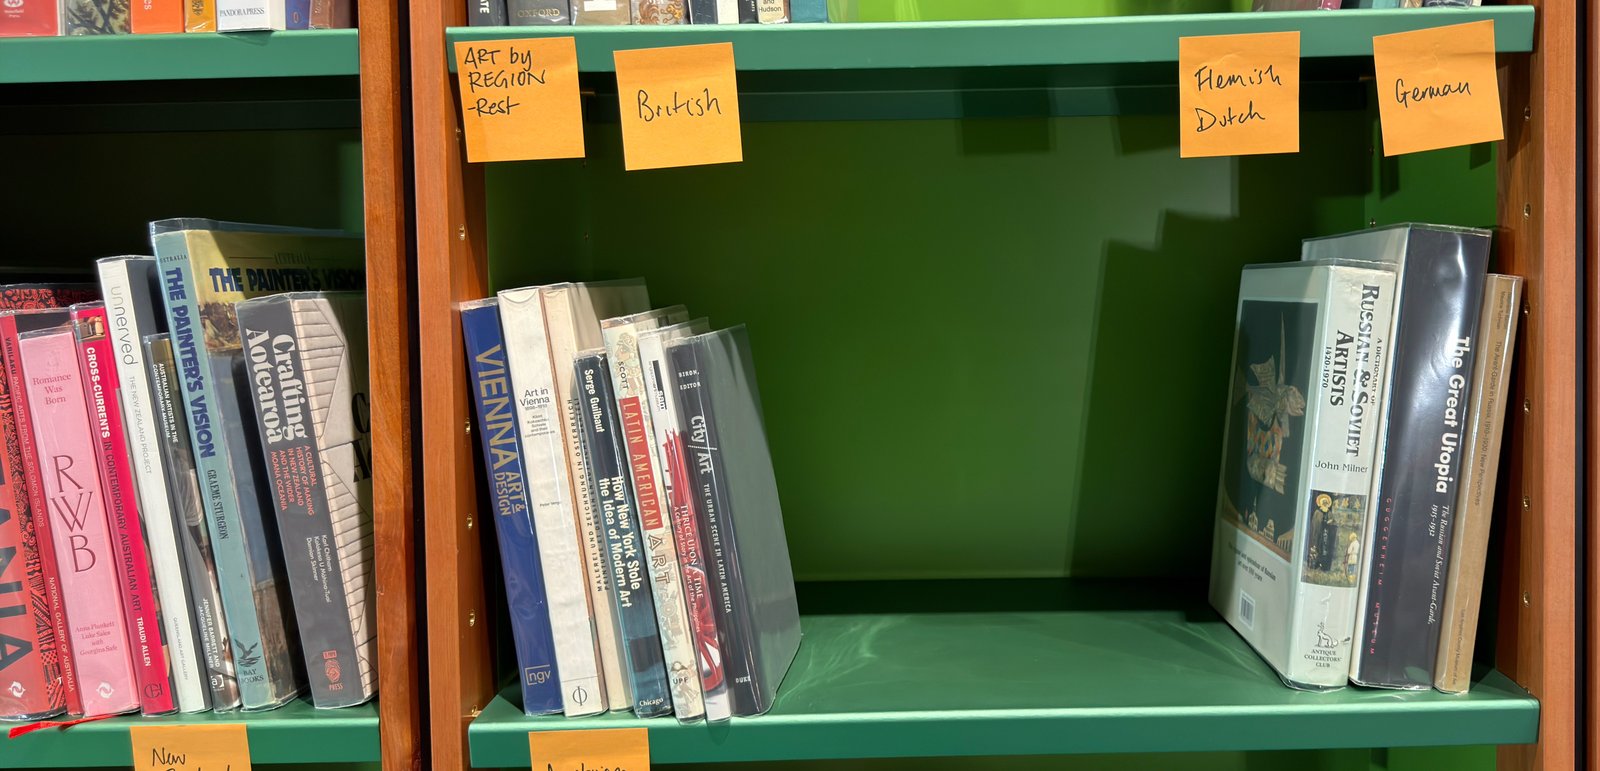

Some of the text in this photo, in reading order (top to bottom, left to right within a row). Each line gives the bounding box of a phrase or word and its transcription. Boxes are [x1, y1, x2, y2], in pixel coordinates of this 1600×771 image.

[220, 7, 265, 17] PANDORA PRESS
[517, 9, 560, 17] OXFORD
[464, 47, 533, 71] ART by
[469, 69, 546, 93] REGION
[1194, 65, 1282, 91] Flemish
[1395, 78, 1471, 108] German
[637, 88, 721, 121] British
[1195, 101, 1265, 132] Dutch
[209, 267, 243, 292] THE
[107, 284, 138, 366] unnerved
[33, 374, 71, 385] Romance
[164, 266, 215, 458] THE PAINTER'S VISION
[617, 360, 628, 390] SCOTT
[1321, 345, 1332, 388] 1420-1970
[1328, 329, 1354, 407] ARTISTS
[1343, 283, 1380, 457] RUSSIAN & SOVIET
[1371, 345, 1382, 392] DICTIONARY
[45, 386, 63, 394] Was
[246, 328, 283, 444] Aotearoa
[273, 334, 308, 440] Crafting
[525, 387, 549, 398] Art in
[582, 368, 597, 395] Serge
[680, 382, 701, 390] EDITOR
[45, 396, 66, 405] Born
[158, 362, 169, 398] AUSTRALIAN
[165, 399, 174, 423] ARTISTS
[170, 431, 178, 443] THE
[474, 343, 520, 470] VIENNA
[520, 396, 550, 407] Vienna
[589, 396, 605, 433] Guilbaut
[1430, 334, 1471, 494] The Great Utopia
[4, 336, 44, 527] VARILAKU PACIFIC ARTS FROM THE SOLOMON ISLANDS
[128, 376, 151, 474] THE NEW ZEALAND PROJECT
[687, 414, 712, 474] City Art
[85, 346, 142, 612] CROSS-CURRENTS IN CONTEMPORARY AUSTRALIAN ART
[270, 451, 287, 510] MOANA OCEANIA
[279, 449, 294, 503] AND THE WIDER
[289, 456, 297, 473] NEW
[295, 446, 314, 515] HISTORY OF MAKING
[305, 451, 317, 486] CULTURAL
[576, 460, 583, 471] IN
[622, 401, 660, 526] LATIN AMERICAN
[1315, 460, 1368, 473] John Milner
[206, 468, 229, 539] GRAEME STURGEON
[292, 474, 303, 506] ZEALAND
[493, 471, 512, 516] DESIGN
[506, 469, 525, 512] ART &
[578, 474, 592, 526] ZEICHNUNG
[680, 503, 693, 536] THRICE
[1440, 504, 1450, 519] The
[587, 530, 596, 548] UND
[597, 477, 632, 608] the Idea of Modern Art
[610, 475, 643, 589] How New York Stole
[703, 483, 731, 613] THE URBAN SCENE IN LATIN AMERICA
[1437, 518, 1448, 544] Russian
[645, 532, 672, 585] ART
[686, 538, 698, 565] UPON
[1433, 559, 1443, 579] Soviet
[1435, 545, 1445, 559] and
[310, 560, 319, 581] Skinner
[590, 551, 603, 592] MALEREI
[693, 576, 704, 598] TIME
[1368, 497, 1392, 654] GUGGENHEIM MUSEUM
[49, 576, 74, 692] NATIONAL GALLERY OF AUSTRALIA
[135, 616, 151, 666] TRAUDI ALLEN
[198, 605, 213, 668] JACQUELINE MILLNER
[202, 598, 212, 626] JENNIFER
[208, 626, 217, 653] BARRETT
[529, 670, 551, 683] ngv
[673, 677, 689, 685] UPF
[639, 697, 664, 706] Chicago
[153, 747, 186, 766] New
